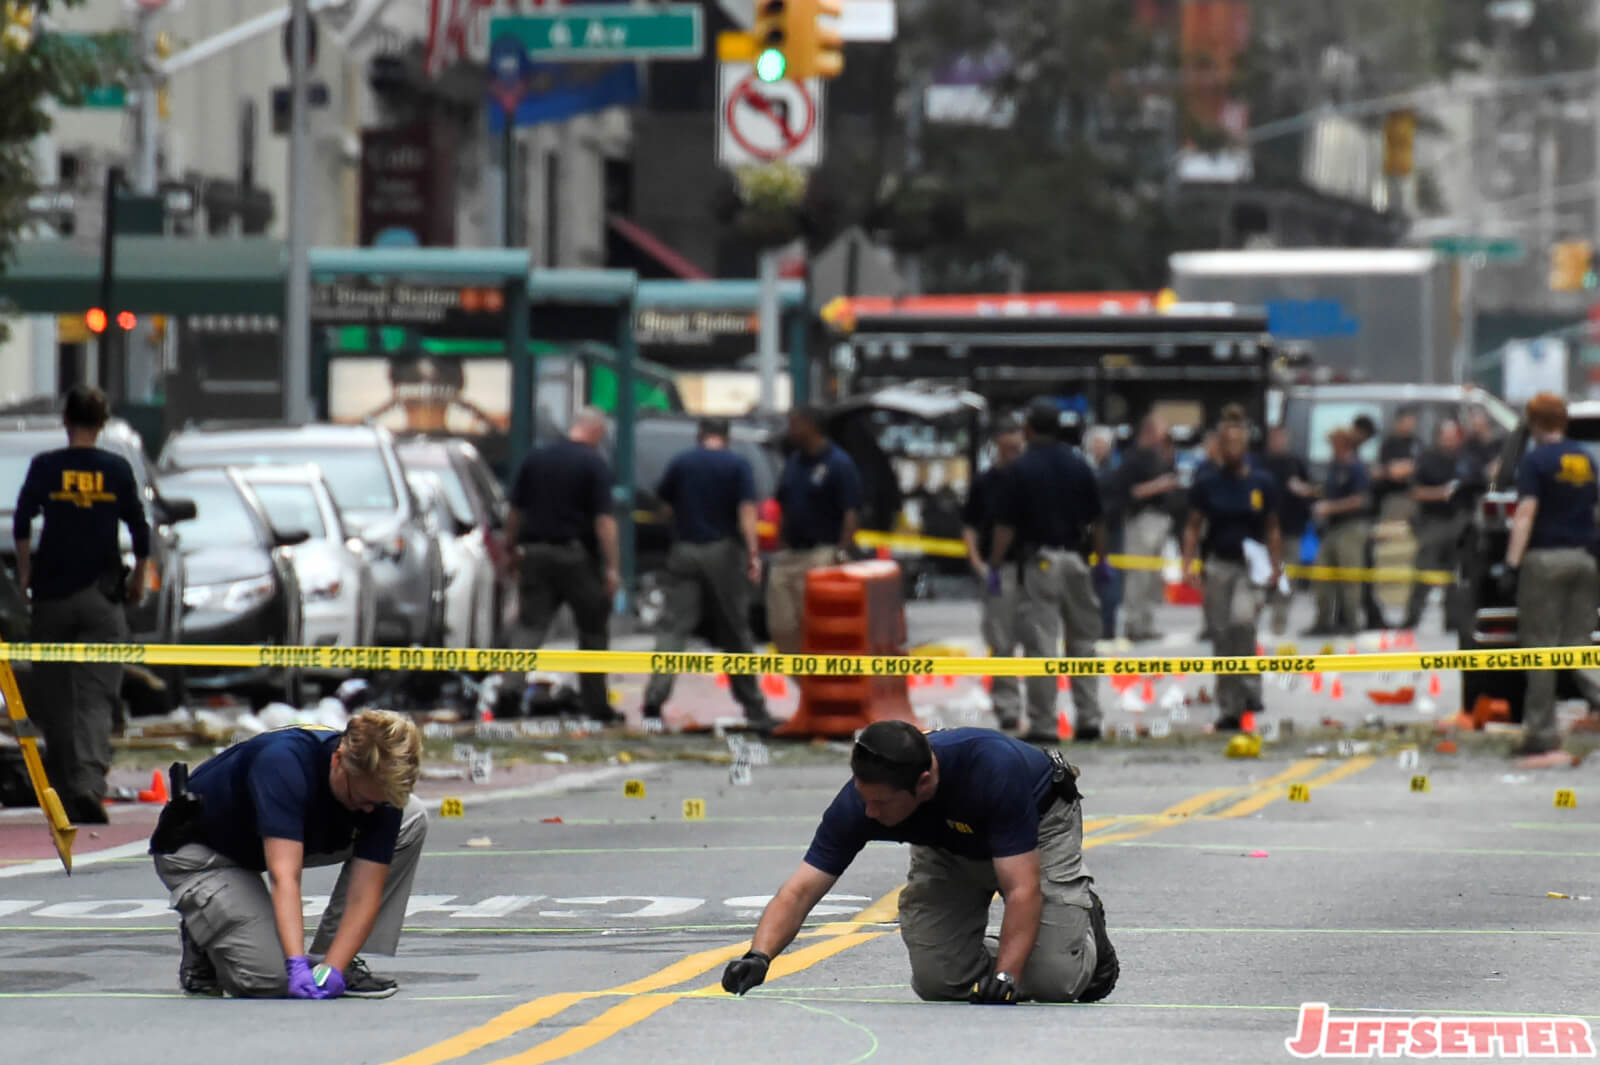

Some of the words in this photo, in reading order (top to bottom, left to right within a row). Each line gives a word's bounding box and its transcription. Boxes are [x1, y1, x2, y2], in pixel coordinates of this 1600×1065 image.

[548, 21, 572, 47] 6
[584, 21, 627, 47] Av
[62, 470, 105, 492] FBI
[684, 801, 701, 818] 31
